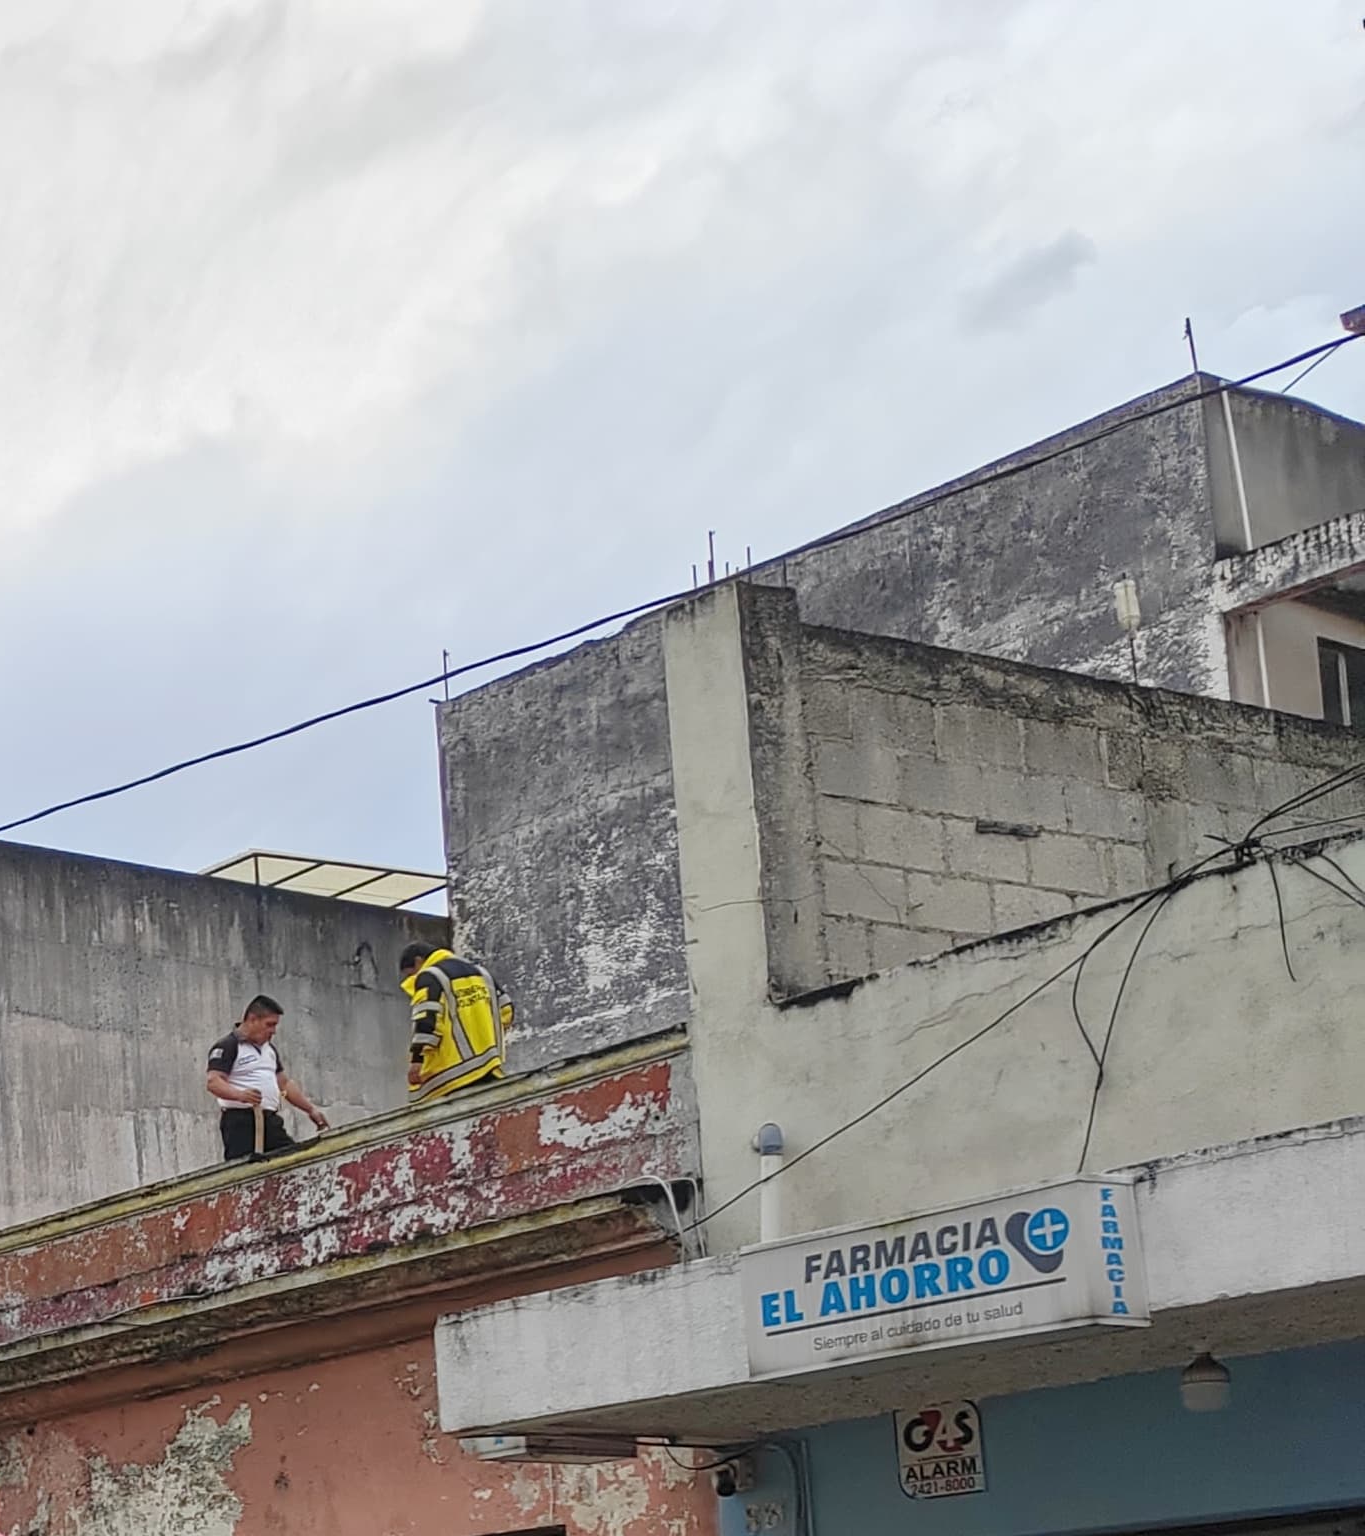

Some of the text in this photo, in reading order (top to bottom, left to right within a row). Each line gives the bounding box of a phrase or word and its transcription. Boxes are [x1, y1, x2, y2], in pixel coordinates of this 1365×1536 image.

[804, 1216, 1002, 1284] FARMACIA
[1099, 1187, 1129, 1315] FARMACIA
[760, 1248, 1011, 1328] EL AHORRO
[813, 1302, 1023, 1351] Siempre al cuidado de tu salud
[903, 1409, 975, 1453] G4S
[905, 1456, 979, 1483] ALARM
[910, 1476, 977, 1496] 2421-8000
